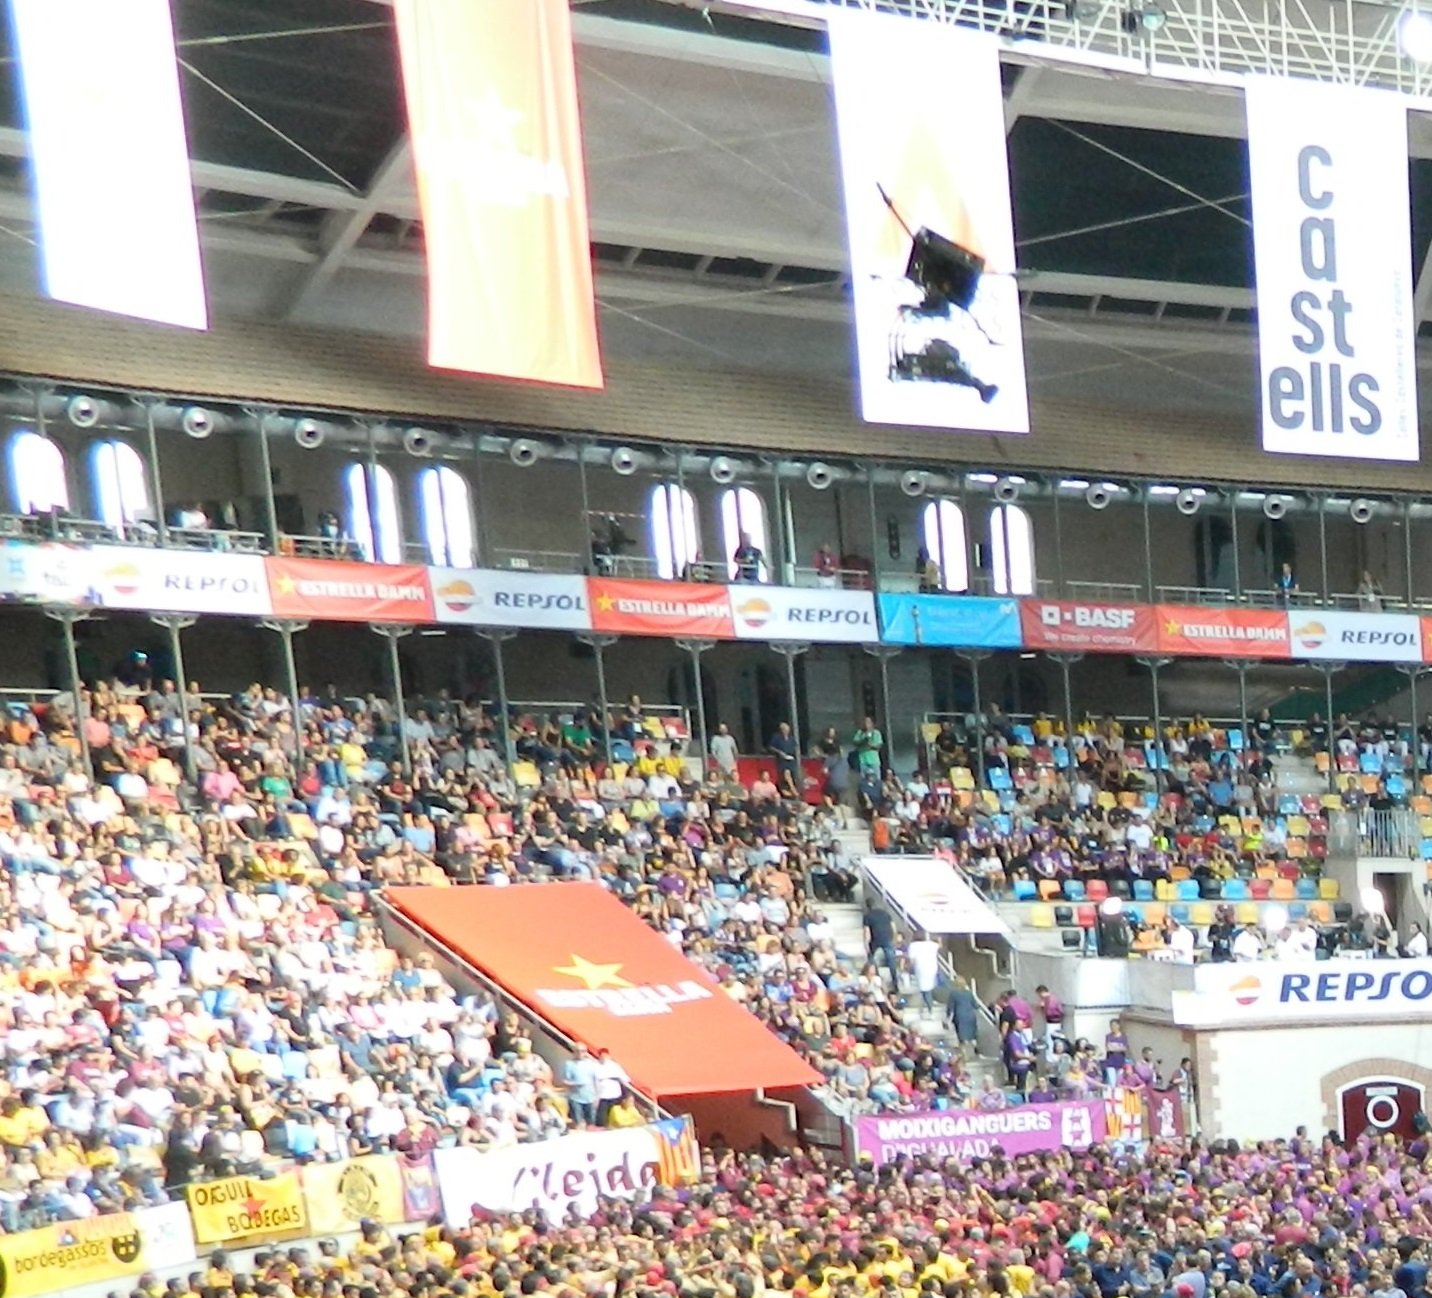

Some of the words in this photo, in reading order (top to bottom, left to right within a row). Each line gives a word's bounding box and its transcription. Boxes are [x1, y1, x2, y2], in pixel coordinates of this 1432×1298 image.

[1297, 144, 1335, 211] c
[1299, 217, 1337, 283] a
[1290, 287, 1355, 358] st
[1268, 363, 1383, 436] ells
[164, 572, 261, 596] REPSOL
[301, 584, 374, 599] ESTRELLA
[494, 590, 586, 611] REPSOL
[618, 599, 684, 617] ESTRELLA
[687, 603, 730, 619] DAMM
[787, 607, 872, 627] REPSOL
[1074, 608, 1136, 629] BASF
[1183, 625, 1243, 640] ESTRELLA
[1246, 627, 1287, 642] DAMM
[1341, 630, 1417, 647] REPSOL
[878, 1111, 1051, 1139] MOIXIGANGUERS
[14, 1240, 107, 1275] bordegassos
